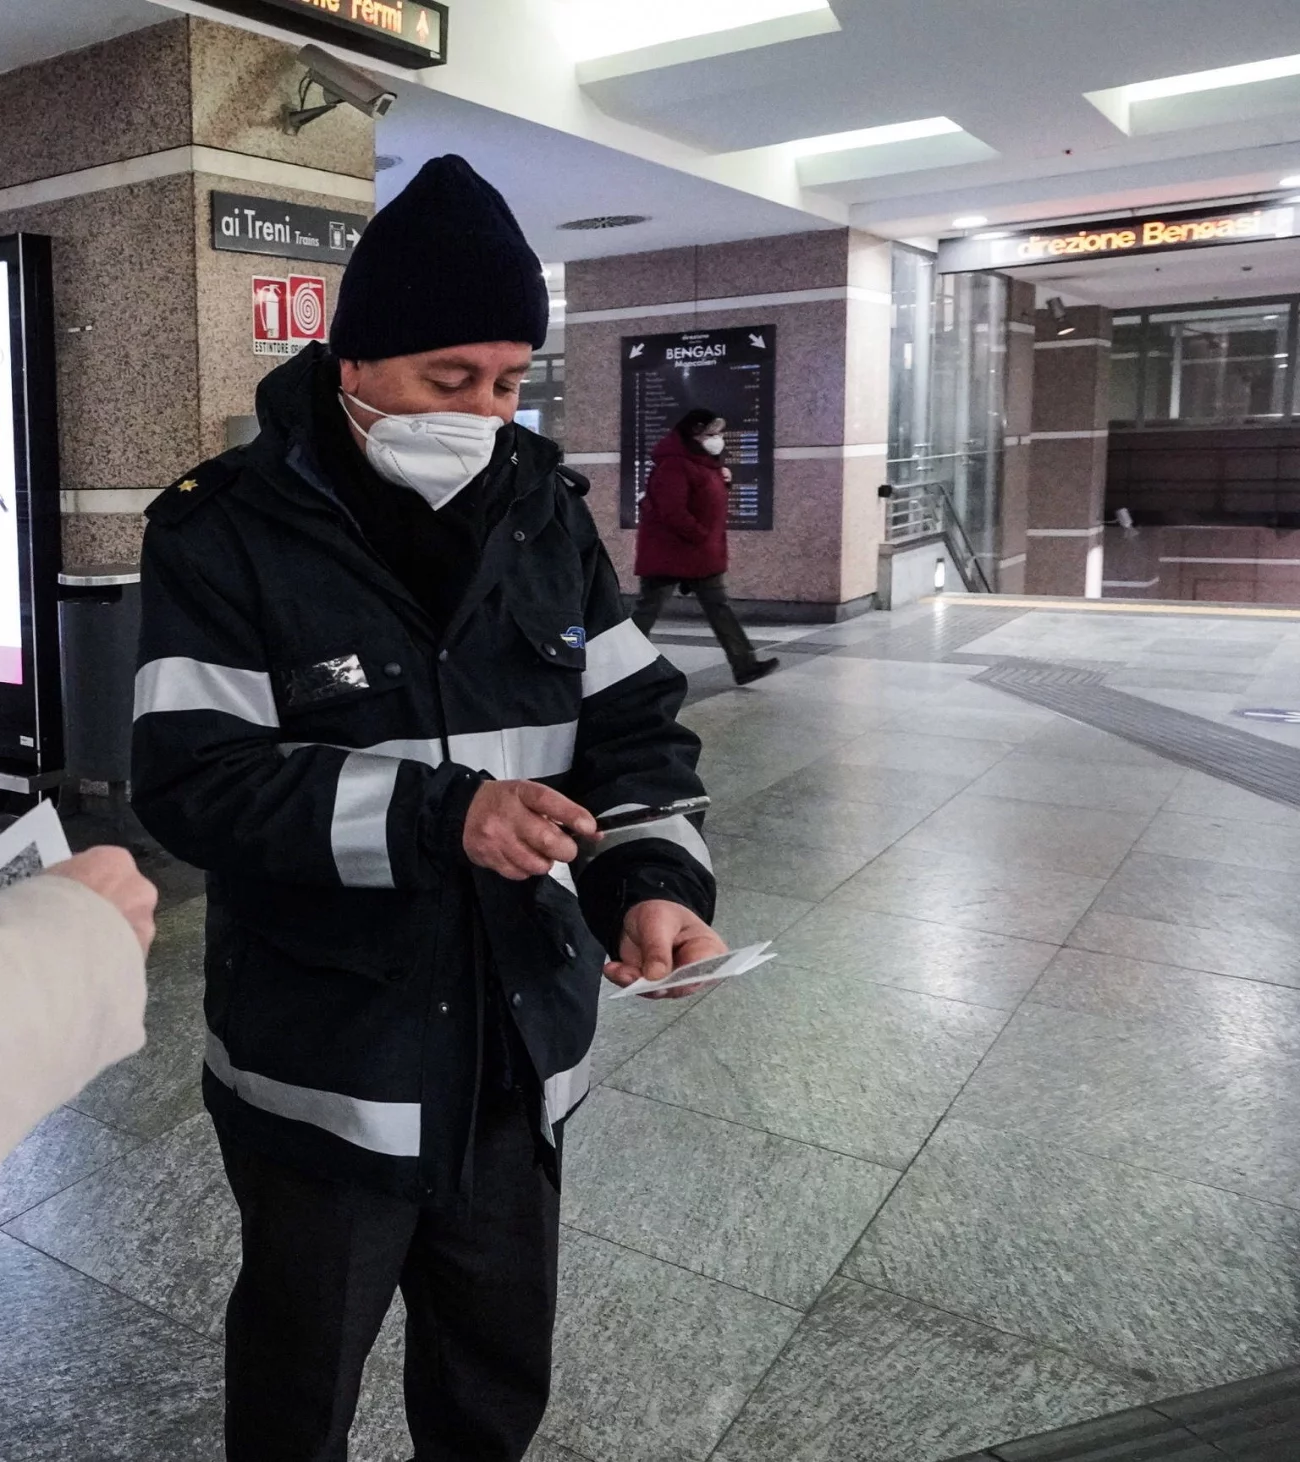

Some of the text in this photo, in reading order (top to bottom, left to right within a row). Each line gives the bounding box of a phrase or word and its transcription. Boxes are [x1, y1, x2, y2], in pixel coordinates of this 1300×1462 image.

[221, 208, 320, 247] ai Treni Trains
[1017, 230, 1137, 258] direzione
[255, 341, 289, 354] ESTINTORE
[665, 344, 726, 360] BENGASI
